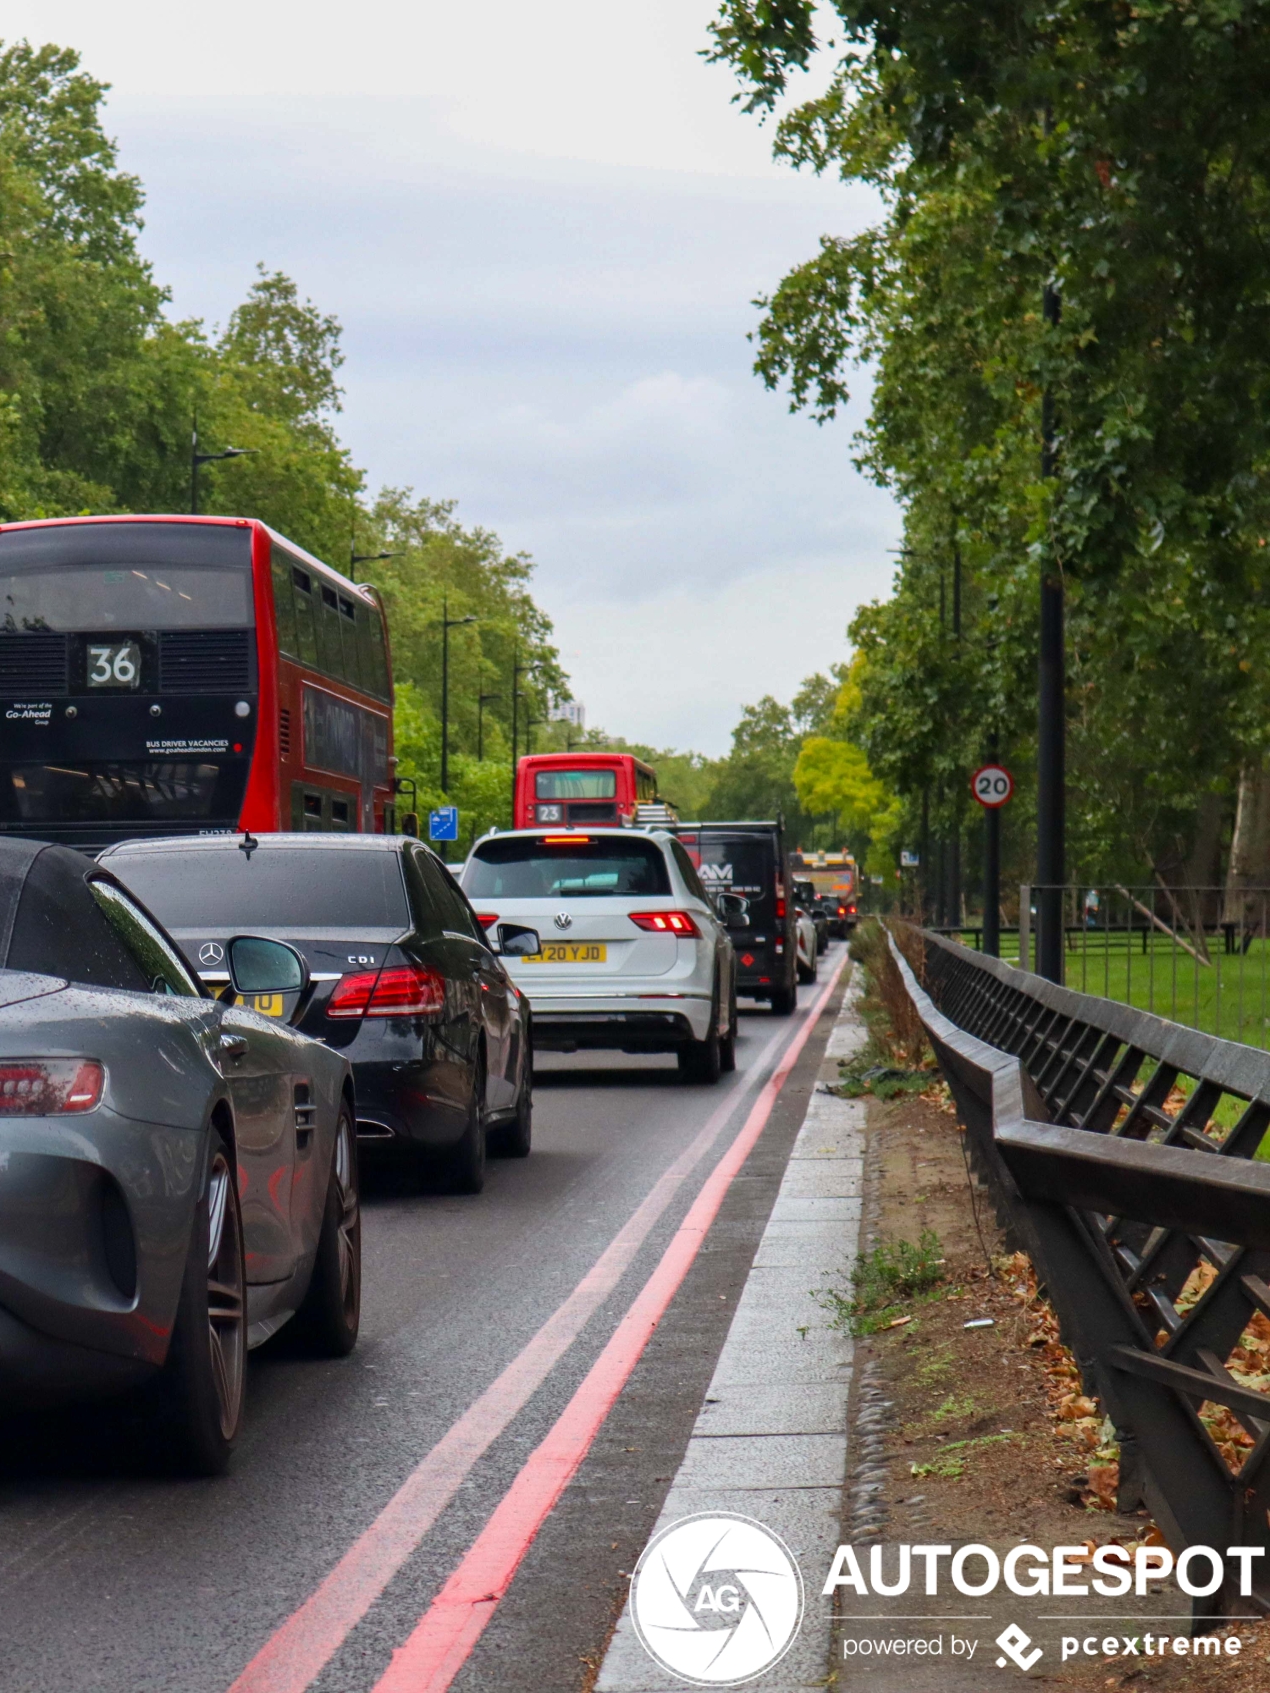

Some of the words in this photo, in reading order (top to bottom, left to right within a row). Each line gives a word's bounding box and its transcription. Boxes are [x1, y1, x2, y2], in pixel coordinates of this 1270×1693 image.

[90, 647, 135, 682] 36
[5, 709, 51, 719] Go-Ahead
[161, 740, 187, 748] DRIVER
[188, 739, 229, 747] VACANCIES
[978, 777, 1008, 795] 20
[539, 805, 559, 821] 23
[347, 955, 375, 964] CDI
[571, 946, 600, 961] YJD
